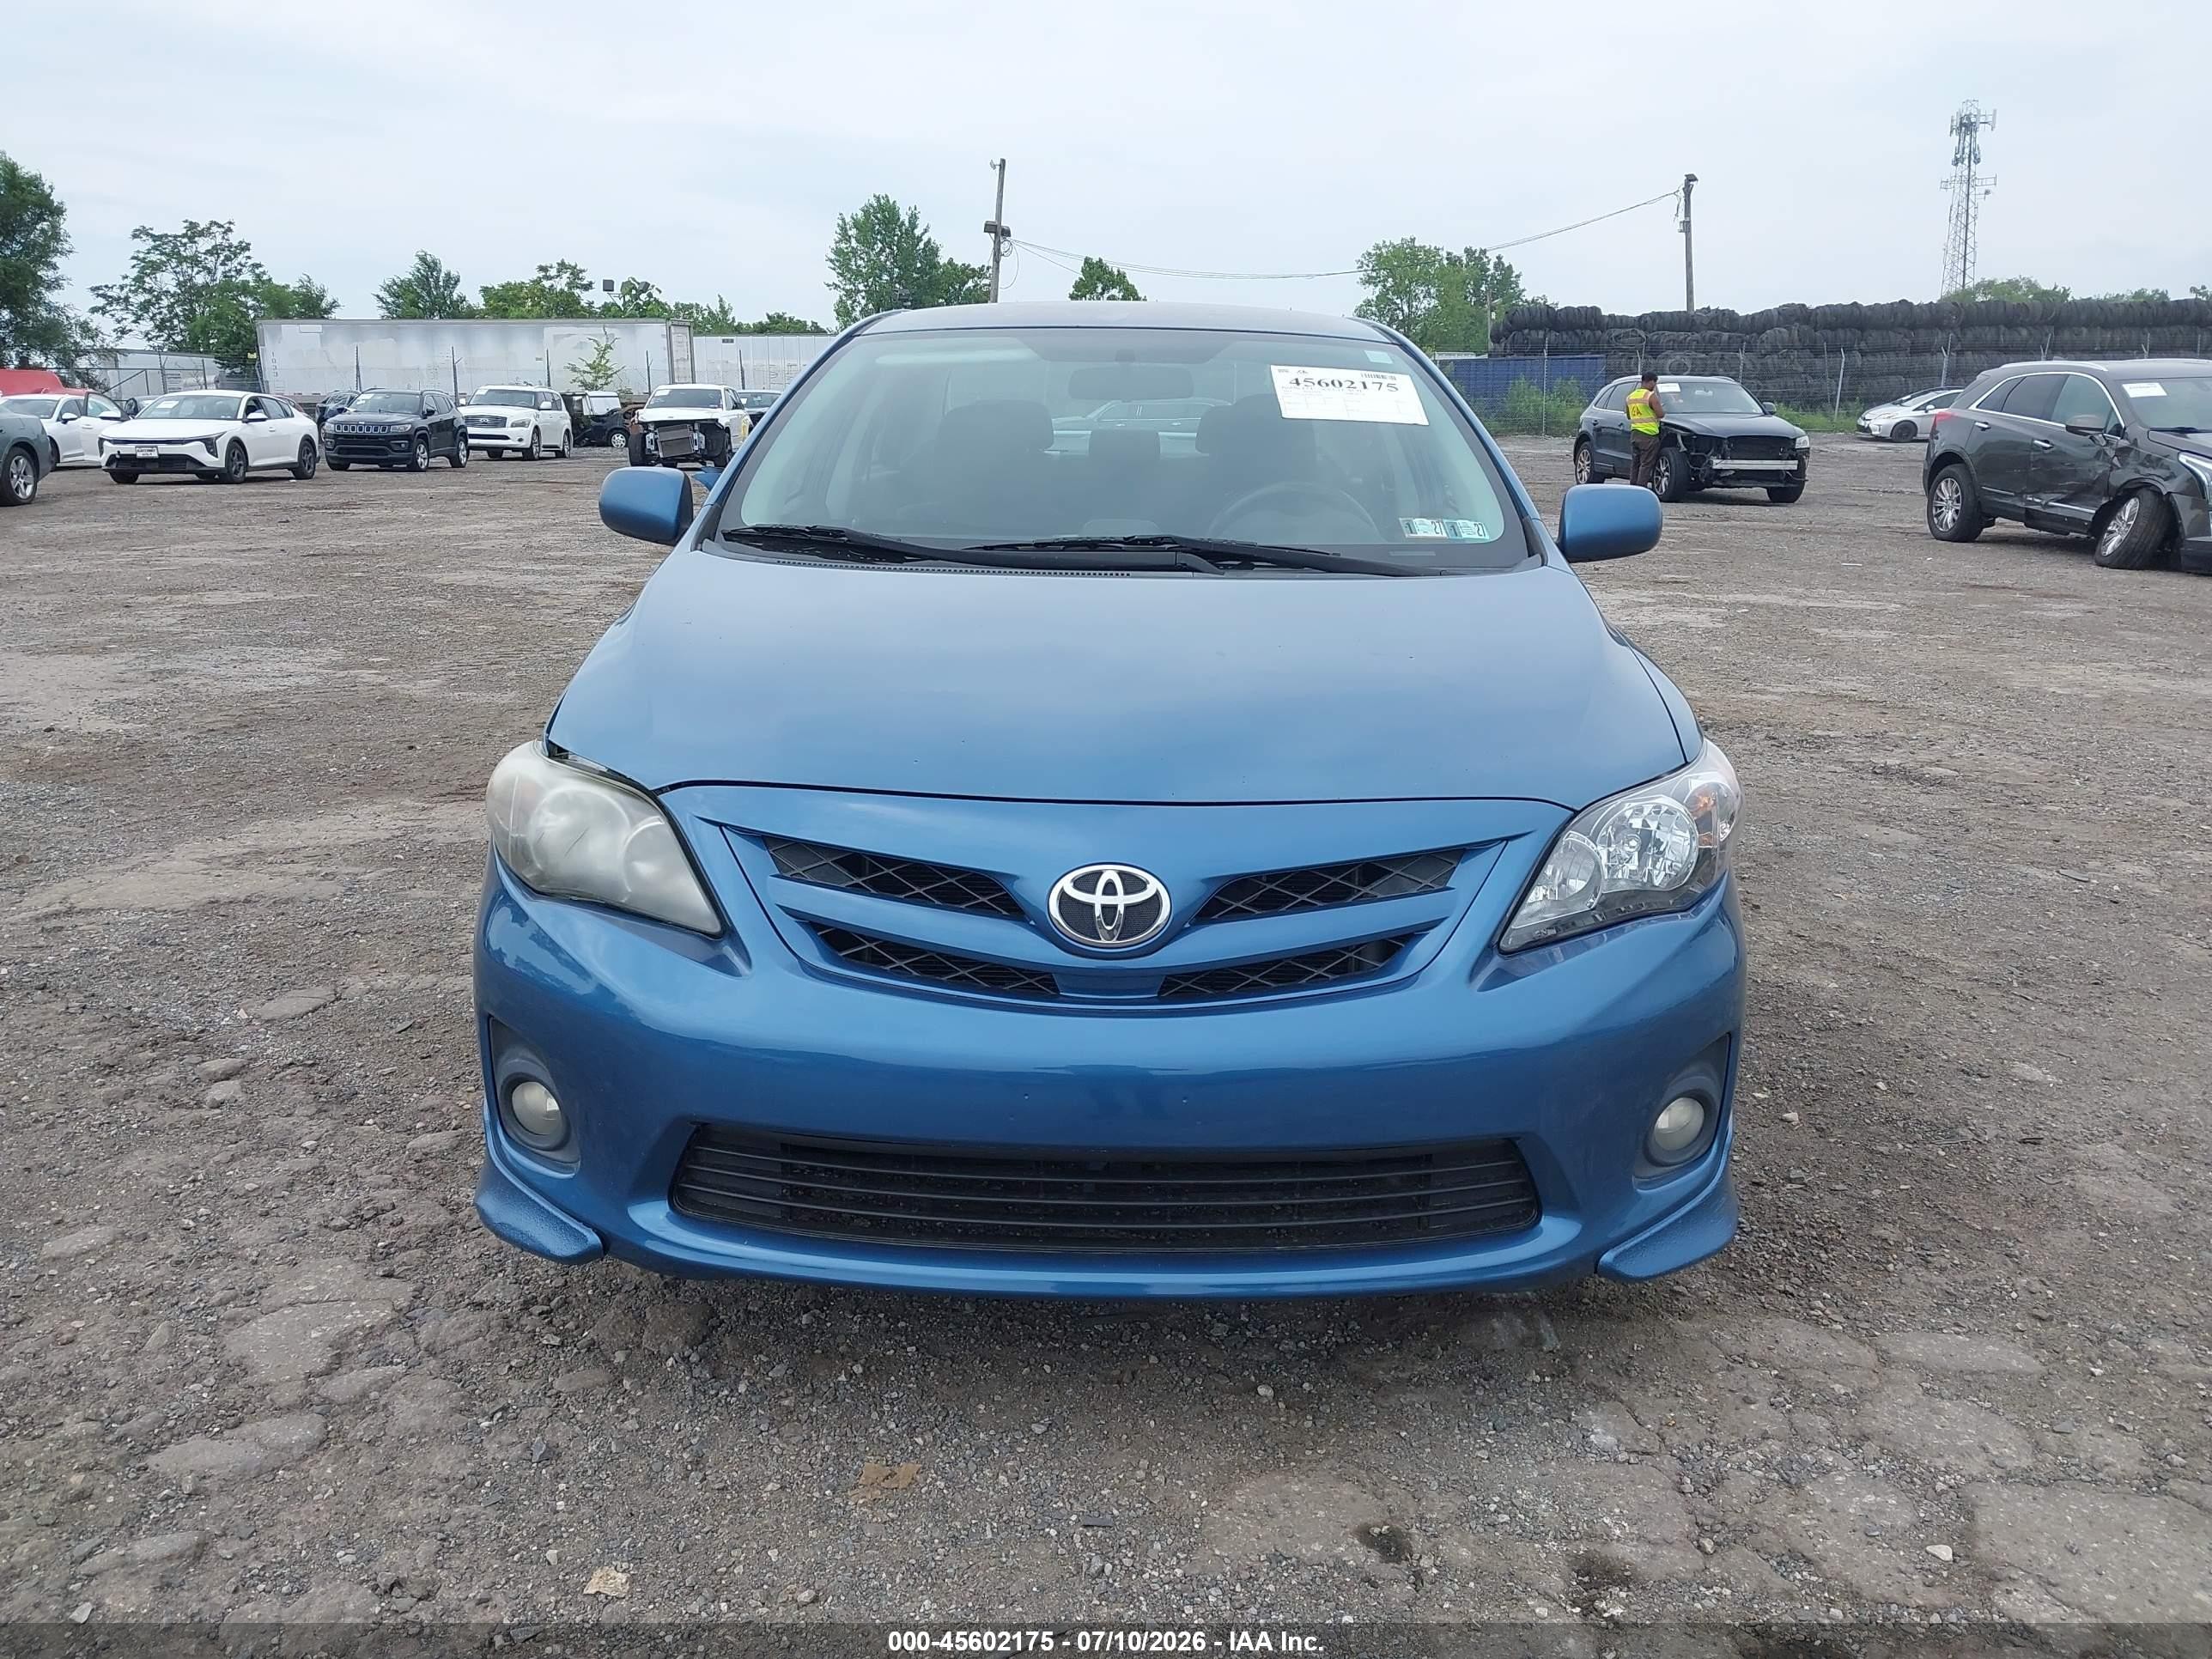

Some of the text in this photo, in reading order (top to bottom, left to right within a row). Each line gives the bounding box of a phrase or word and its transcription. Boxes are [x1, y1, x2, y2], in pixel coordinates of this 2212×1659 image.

[1289, 377, 1400, 392] 45602175
[1431, 520, 1443, 535] 27
[1474, 523, 1486, 537] 27
